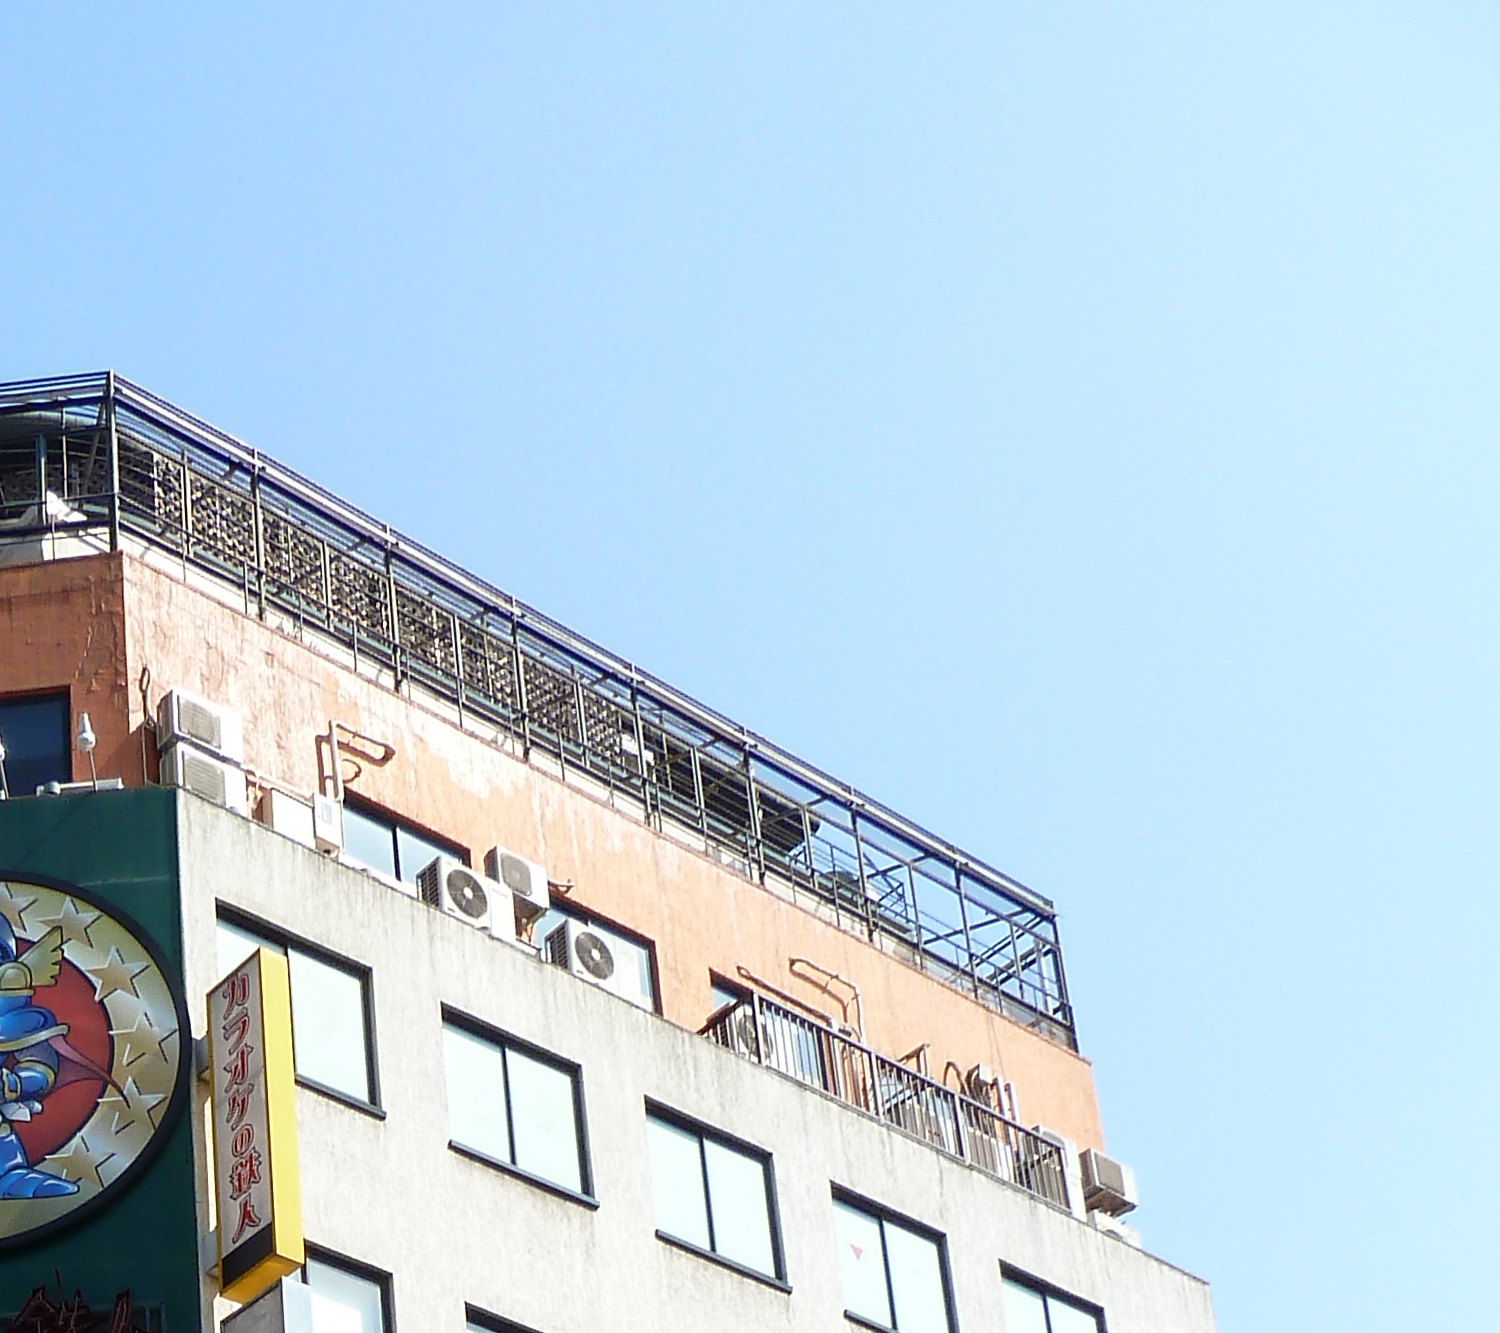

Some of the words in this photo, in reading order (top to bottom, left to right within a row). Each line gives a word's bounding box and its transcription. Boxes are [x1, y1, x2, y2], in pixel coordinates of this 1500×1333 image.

[221, 972, 262, 1245] カラオケの鉄人
